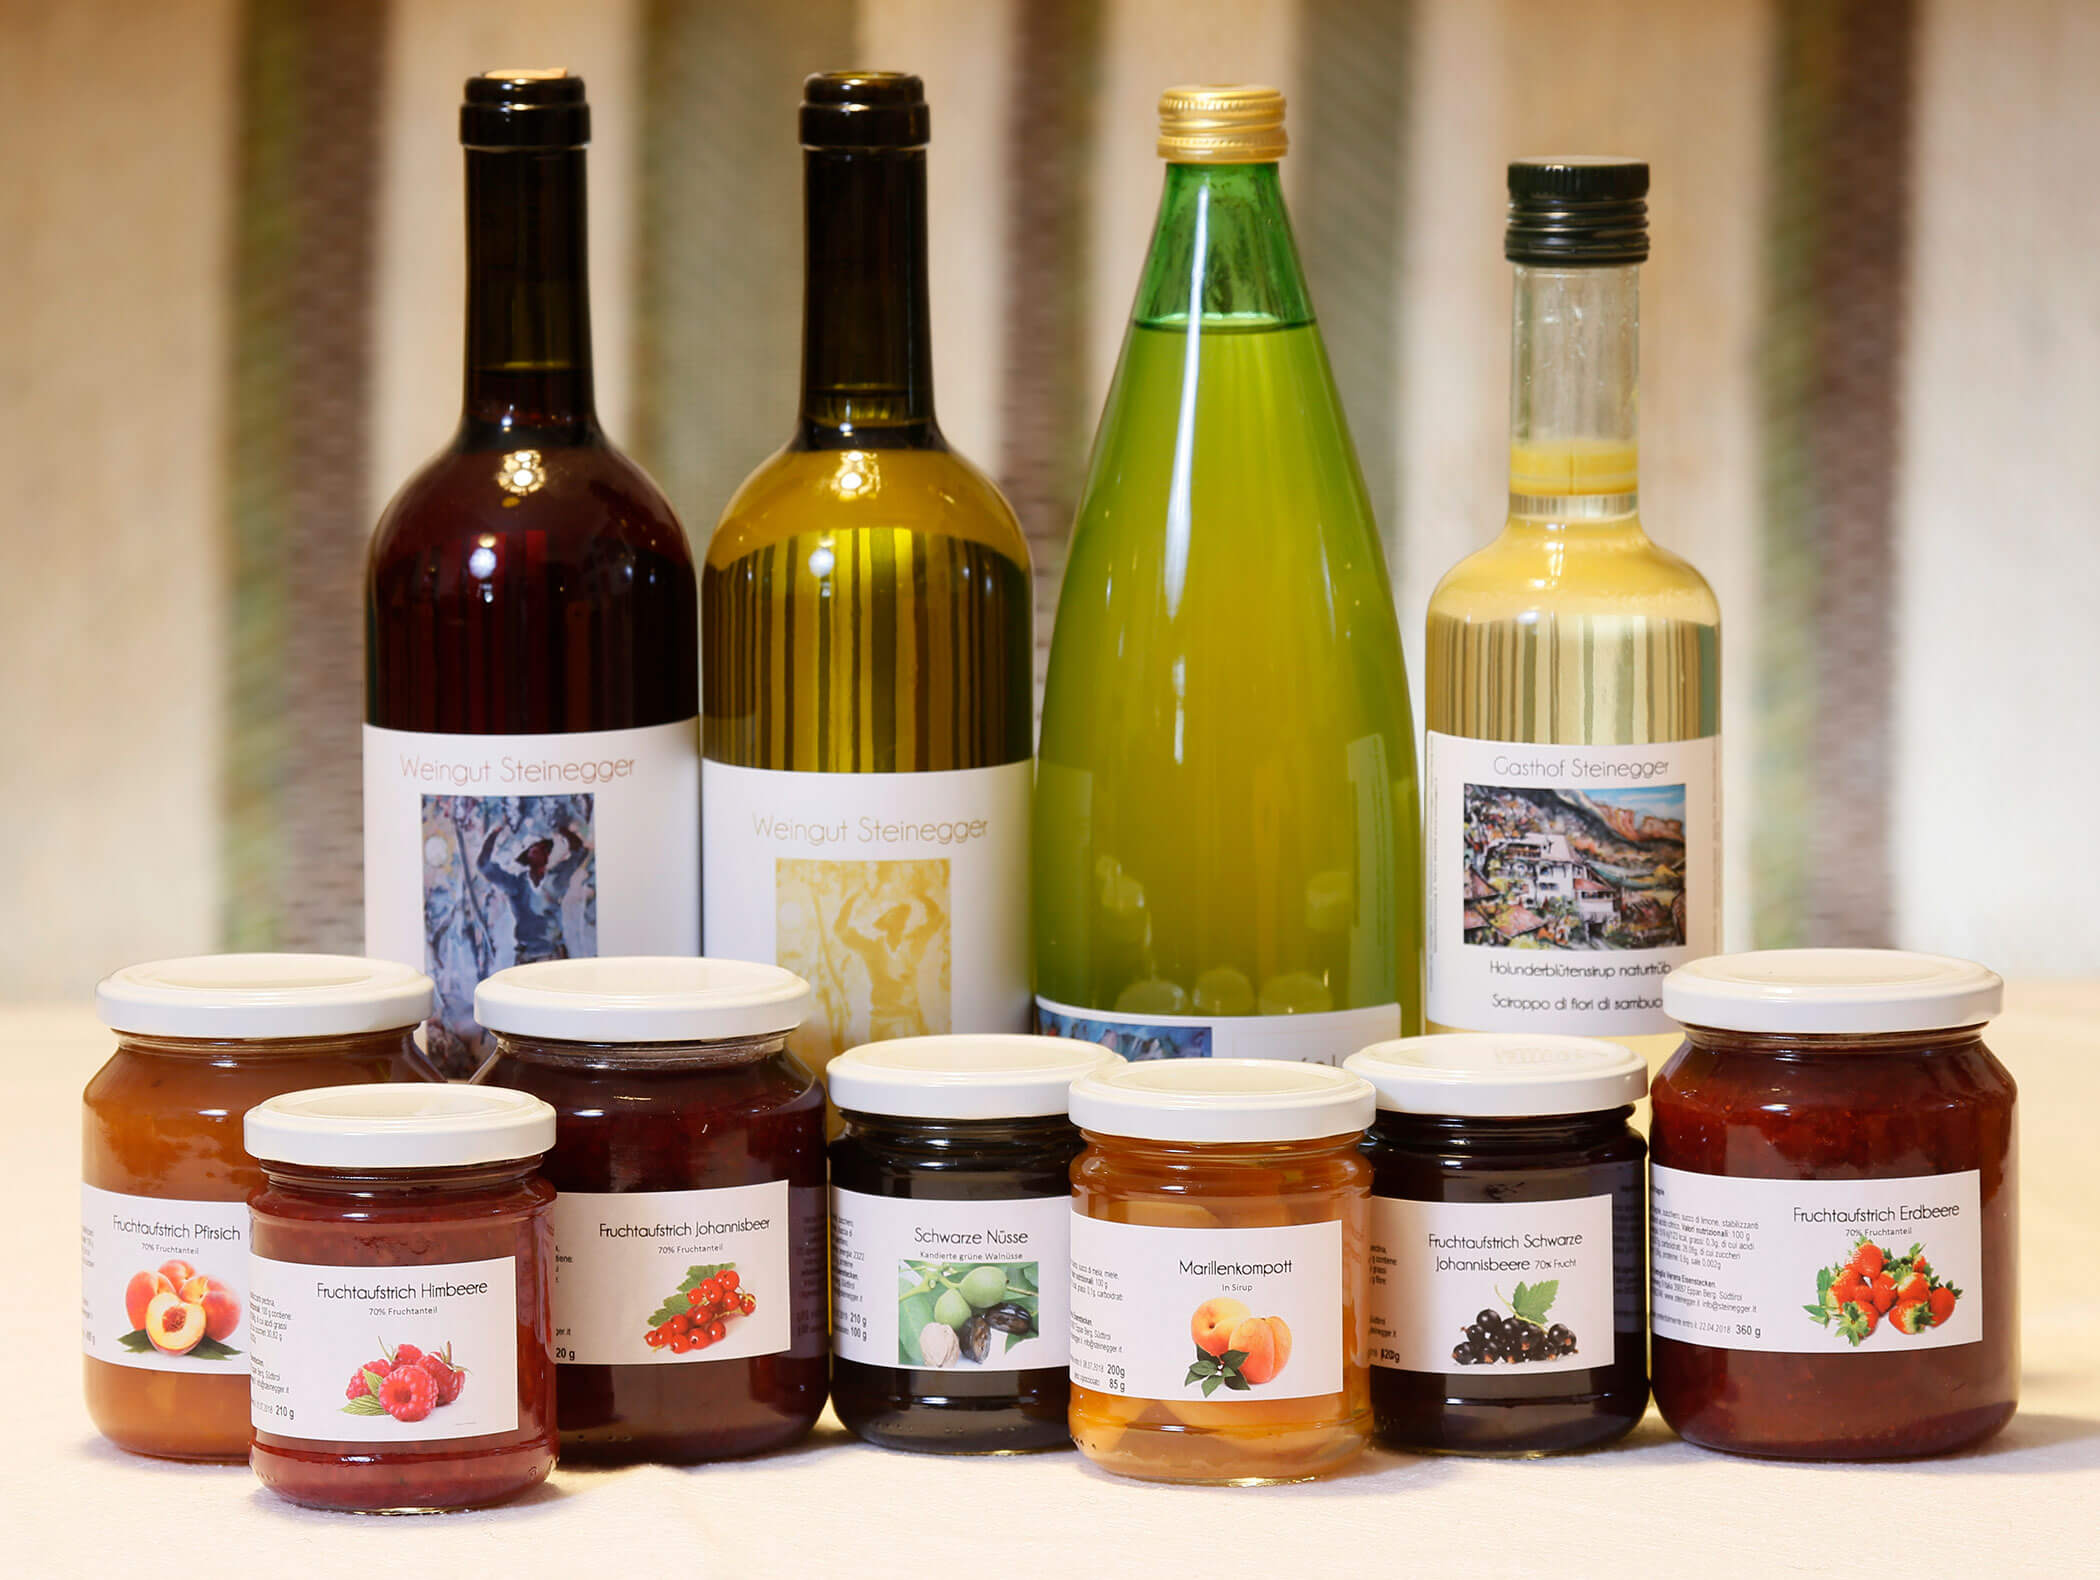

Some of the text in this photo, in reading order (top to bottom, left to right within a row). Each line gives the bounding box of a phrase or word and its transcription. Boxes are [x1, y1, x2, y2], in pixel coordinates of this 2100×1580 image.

[400, 753, 635, 786] Weingut Steinegger
[1494, 755, 1669, 779] Gasthof Steinegger
[752, 811, 988, 846] Weingut Steinegger
[1490, 960, 1671, 979] Holunderblütensirup naturtrüb
[1492, 994, 1550, 1011] Sciroppo
[1555, 996, 1567, 1010] di
[1571, 996, 1593, 1010] fiori
[1598, 996, 1610, 1010] di
[1793, 1203, 1960, 1223] Fruchtaufstrich Erdbeere
[113, 1214, 240, 1241] Fruchtaufstrich Pfirsich
[598, 1218, 770, 1239] Fruchtaufstrich Johannisbeer
[1865, 1227, 1912, 1237] Fruchtanteil
[914, 1227, 1029, 1245] Schwarze Nüsse
[1428, 1233, 1583, 1249] Fruchtaufstrich Schwarze
[156, 1244, 199, 1255] Fruchtanteil
[658, 1244, 723, 1255] 70% Fruchtanteil
[920, 1251, 957, 1260] Kandierte
[984, 1252, 1023, 1261] Walnüsse
[1178, 1259, 1293, 1278] Marillenkompott
[1435, 1257, 1530, 1273] Johannisbeere
[1554, 1258, 1577, 1270] Frucht
[316, 1281, 488, 1300] Fruchtaufstrich Himbeere
[1231, 1283, 1253, 1293] Sirup
[368, 1305, 438, 1316] 70% Fruchtanteil
[850, 1311, 860, 1324] 210
[851, 1326, 861, 1338] 100
[1736, 1324, 1752, 1336] 360
[1754, 1327, 1761, 1339] g
[1107, 1363, 1125, 1379] 200g
[1109, 1378, 1120, 1390] 85
[276, 1404, 287, 1418] 210
[288, 1408, 295, 1420] g
